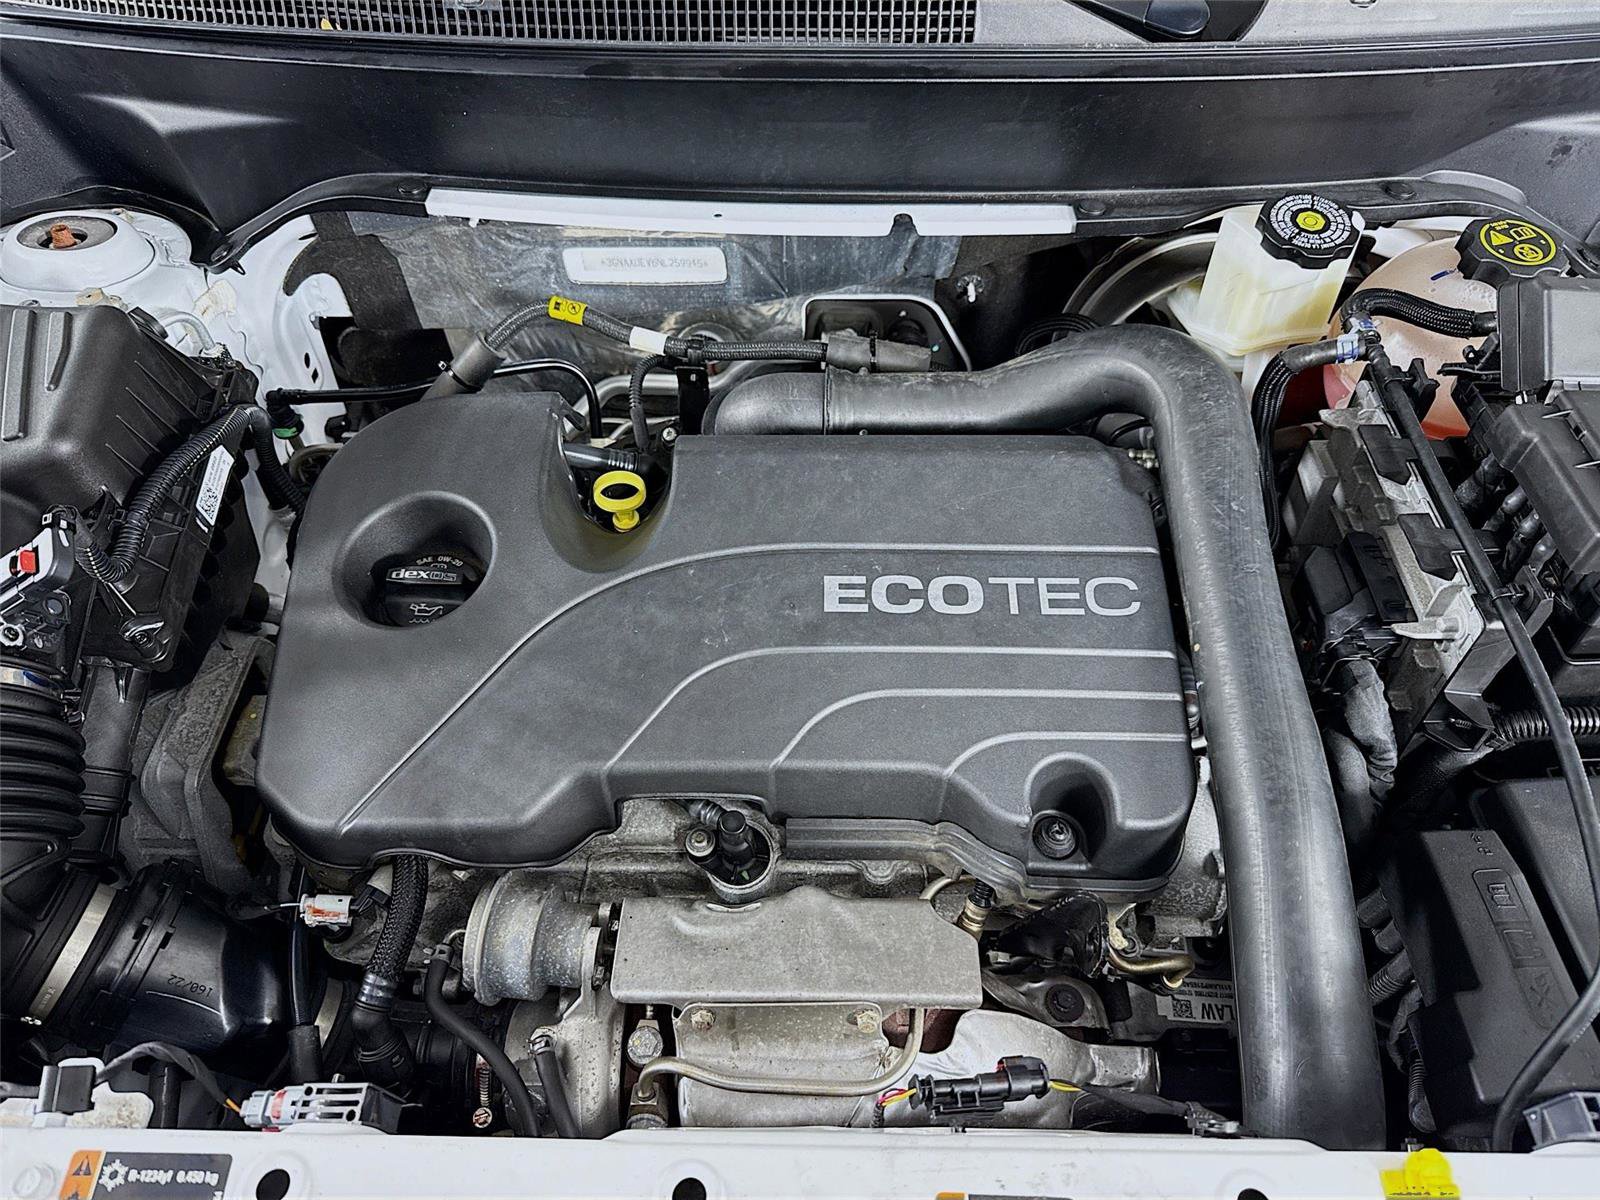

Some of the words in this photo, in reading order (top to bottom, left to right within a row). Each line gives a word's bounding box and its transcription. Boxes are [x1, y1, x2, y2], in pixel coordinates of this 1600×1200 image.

[416, 556, 433, 565] SAE
[437, 556, 464, 567] 0W-20
[391, 568, 457, 582] dexos
[823, 575, 1142, 616] ECOTEC
[167, 974, 213, 998] 160/22
[1201, 1003, 1235, 1021] LAW
